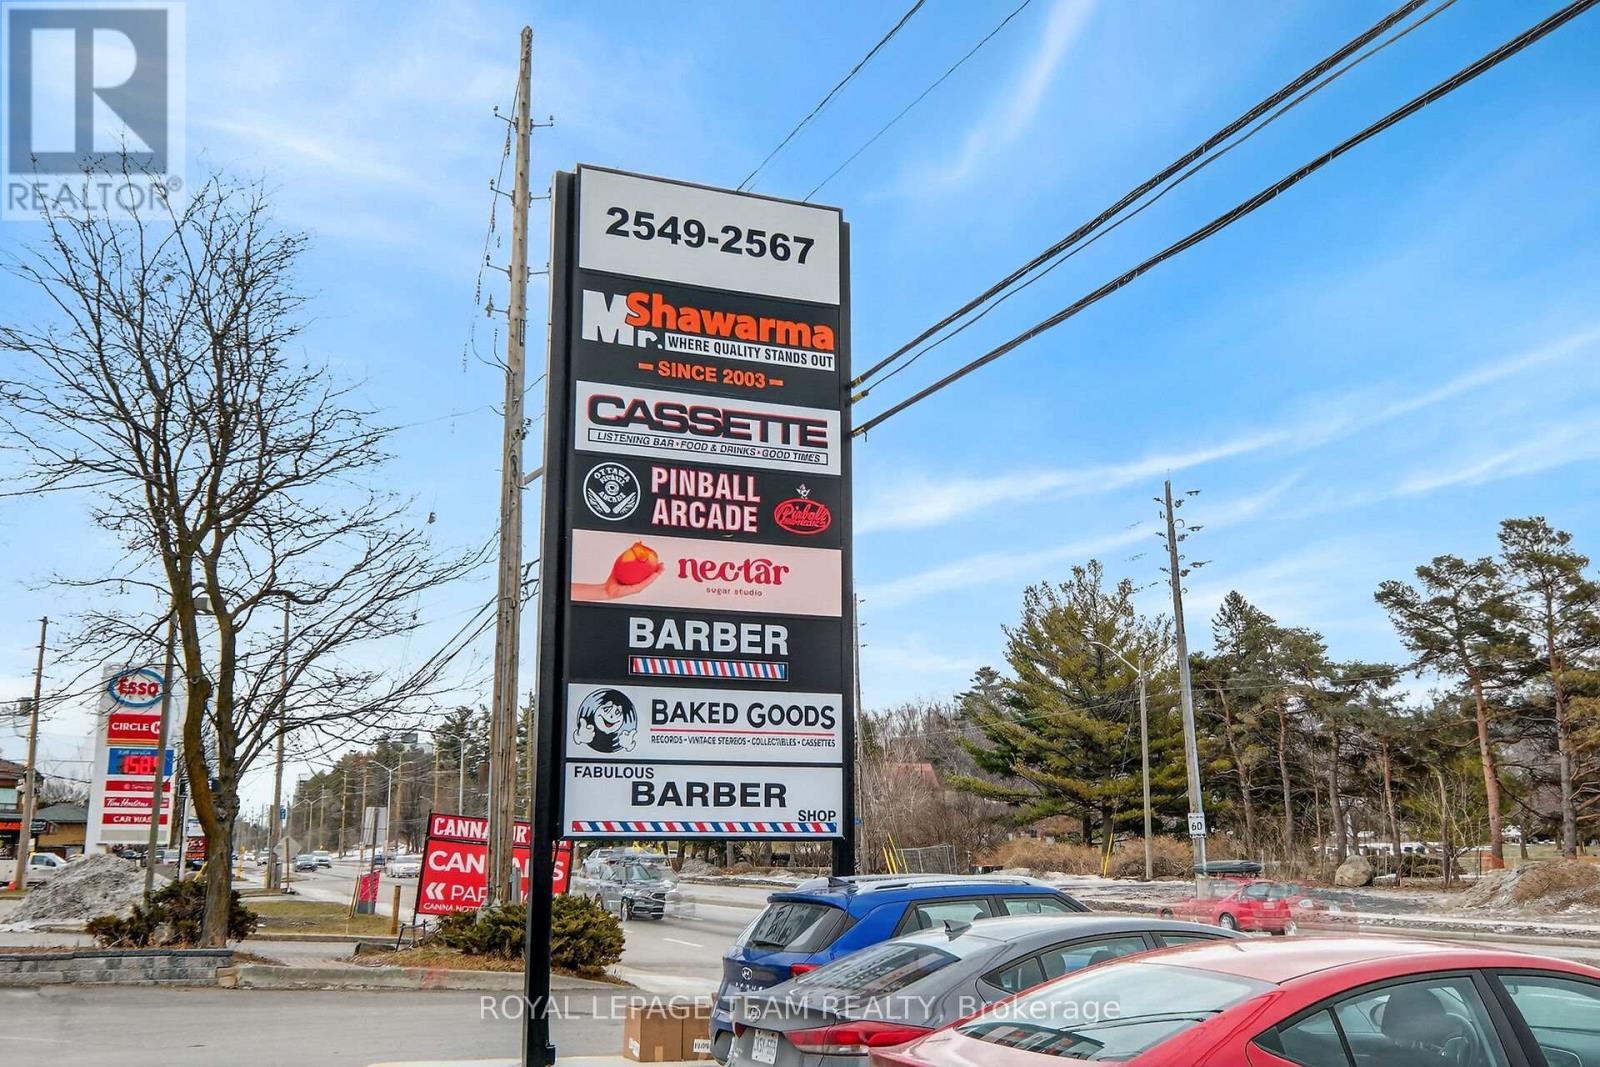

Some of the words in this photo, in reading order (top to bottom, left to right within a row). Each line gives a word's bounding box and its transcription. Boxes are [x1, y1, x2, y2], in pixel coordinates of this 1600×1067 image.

[605, 207, 815, 264] 2549-2567
[582, 289, 663, 350] Mr.
[624, 291, 835, 351] Shawarma
[667, 335, 710, 353] WHERE
[713, 341, 761, 360] QUALITY
[764, 348, 808, 366] STANDS
[811, 353, 834, 369] OUT
[658, 360, 717, 383] SINCE
[722, 369, 766, 389] 2003
[587, 393, 829, 449] CASSETTE
[597, 431, 650, 445] LISTENING
[653, 437, 674, 448] BAR
[680, 440, 708, 452] FOOD
[710, 443, 717, 452] &
[720, 444, 756, 456] DRINKS
[762, 448, 790, 459] GOOD
[793, 451, 821, 463] TIMES
[651, 466, 761, 502] PINBALL
[651, 498, 758, 533] ARCADE
[678, 558, 790, 585] nectar
[706, 587, 731, 596] sugar
[735, 588, 763, 597] studio
[628, 616, 788, 656] BARBER
[111, 722, 149, 731] CIRCLE
[651, 698, 739, 725] BAKED
[746, 702, 836, 730] GOODS
[651, 735, 683, 744] RECORDS
[687, 736, 717, 745] VINTAGE
[718, 737, 747, 746] STEREOS
[751, 737, 797, 747] COLLECTIBLES
[801, 738, 836, 748] CASSETTES
[574, 765, 654, 780] FABULOUS
[631, 781, 787, 808] BARBER
[798, 809, 836, 822] SHOP
[1191, 821, 1203, 831] 60
